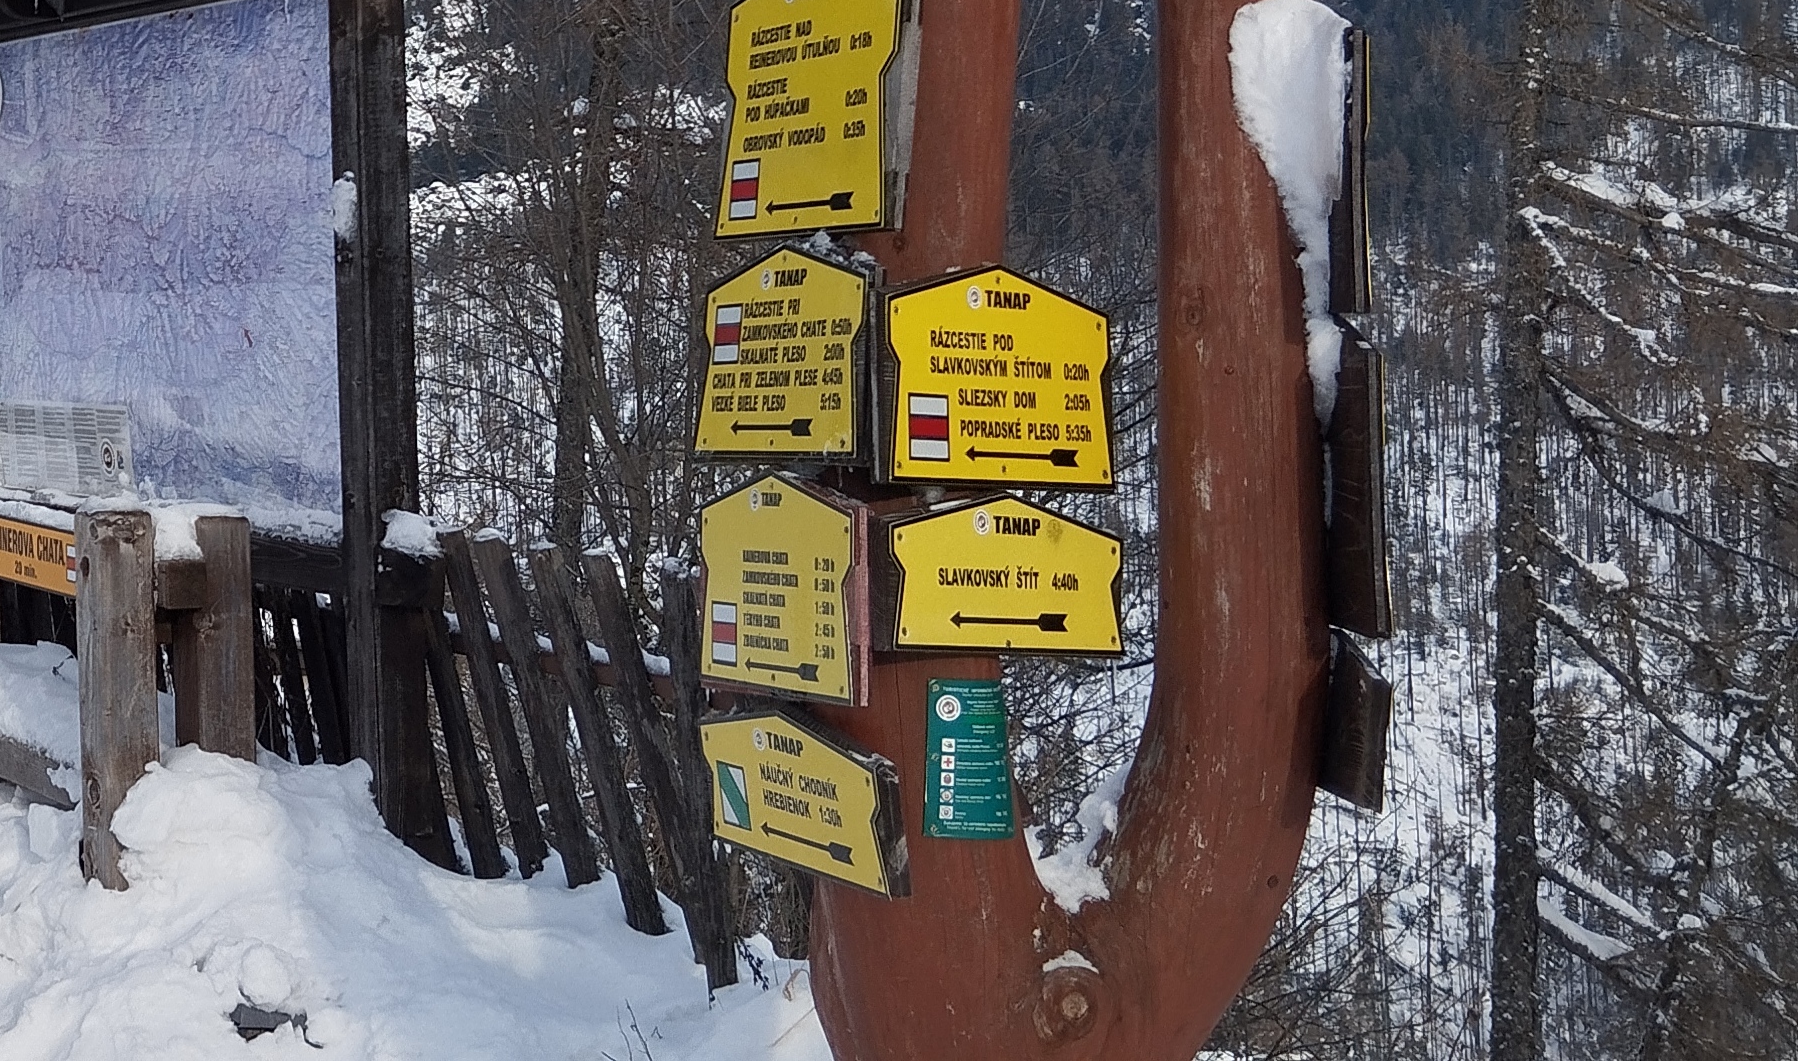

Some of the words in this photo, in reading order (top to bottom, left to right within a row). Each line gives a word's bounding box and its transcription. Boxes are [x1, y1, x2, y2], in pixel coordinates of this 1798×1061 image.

[751, 24, 792, 48] RÁZCESTIE
[795, 19, 812, 38] NAD
[747, 77, 789, 101] RÁZCESTIE
[745, 105, 760, 123] POD
[743, 127, 785, 153] OBROVSKÝ
[787, 123, 826, 148] VODOPÁD
[773, 268, 808, 288] TANAP
[743, 298, 784, 319] RÁZCESTIE
[787, 298, 801, 316] PRI
[984, 290, 1031, 310] TANAP
[800, 319, 827, 339] CHATE
[930, 326, 988, 351] RÁZCESTIE
[993, 334, 1014, 352] POD
[781, 345, 807, 364] PLESO
[712, 372, 736, 390] CHATA
[740, 372, 752, 389] PRI
[755, 370, 791, 388] ZELENOM
[793, 368, 819, 387] PLESE
[929, 355, 1008, 378] SLAVKOVSKÝM
[1013, 354, 1052, 380] ŠTÍTOM
[1063, 363, 1090, 382] 0:20h
[761, 394, 786, 412] PLESO
[958, 387, 1008, 409] SLIEZSKY
[1013, 391, 1037, 409] DOM
[1064, 393, 1091, 412] 2:05h
[960, 417, 1022, 440] POPRADSKÉ
[1027, 423, 1060, 442] PLESO
[1065, 424, 1092, 443] 5:35h
[992, 515, 1041, 537] TANAP
[36, 534, 66, 566] CHATA
[14, 560, 22, 575] 20
[24, 564, 37, 578] min.
[938, 565, 1010, 589] SLAVKOVSKÝ
[1015, 565, 1040, 590] ŠTÍT
[1051, 572, 1079, 592] 4:40h
[765, 731, 804, 757] TANAP
[759, 761, 795, 789] NÁUČNÝ
[798, 774, 839, 802] CHODNÍK
[762, 788, 812, 819] HREBIENOK
[818, 804, 843, 828] 1:30h
